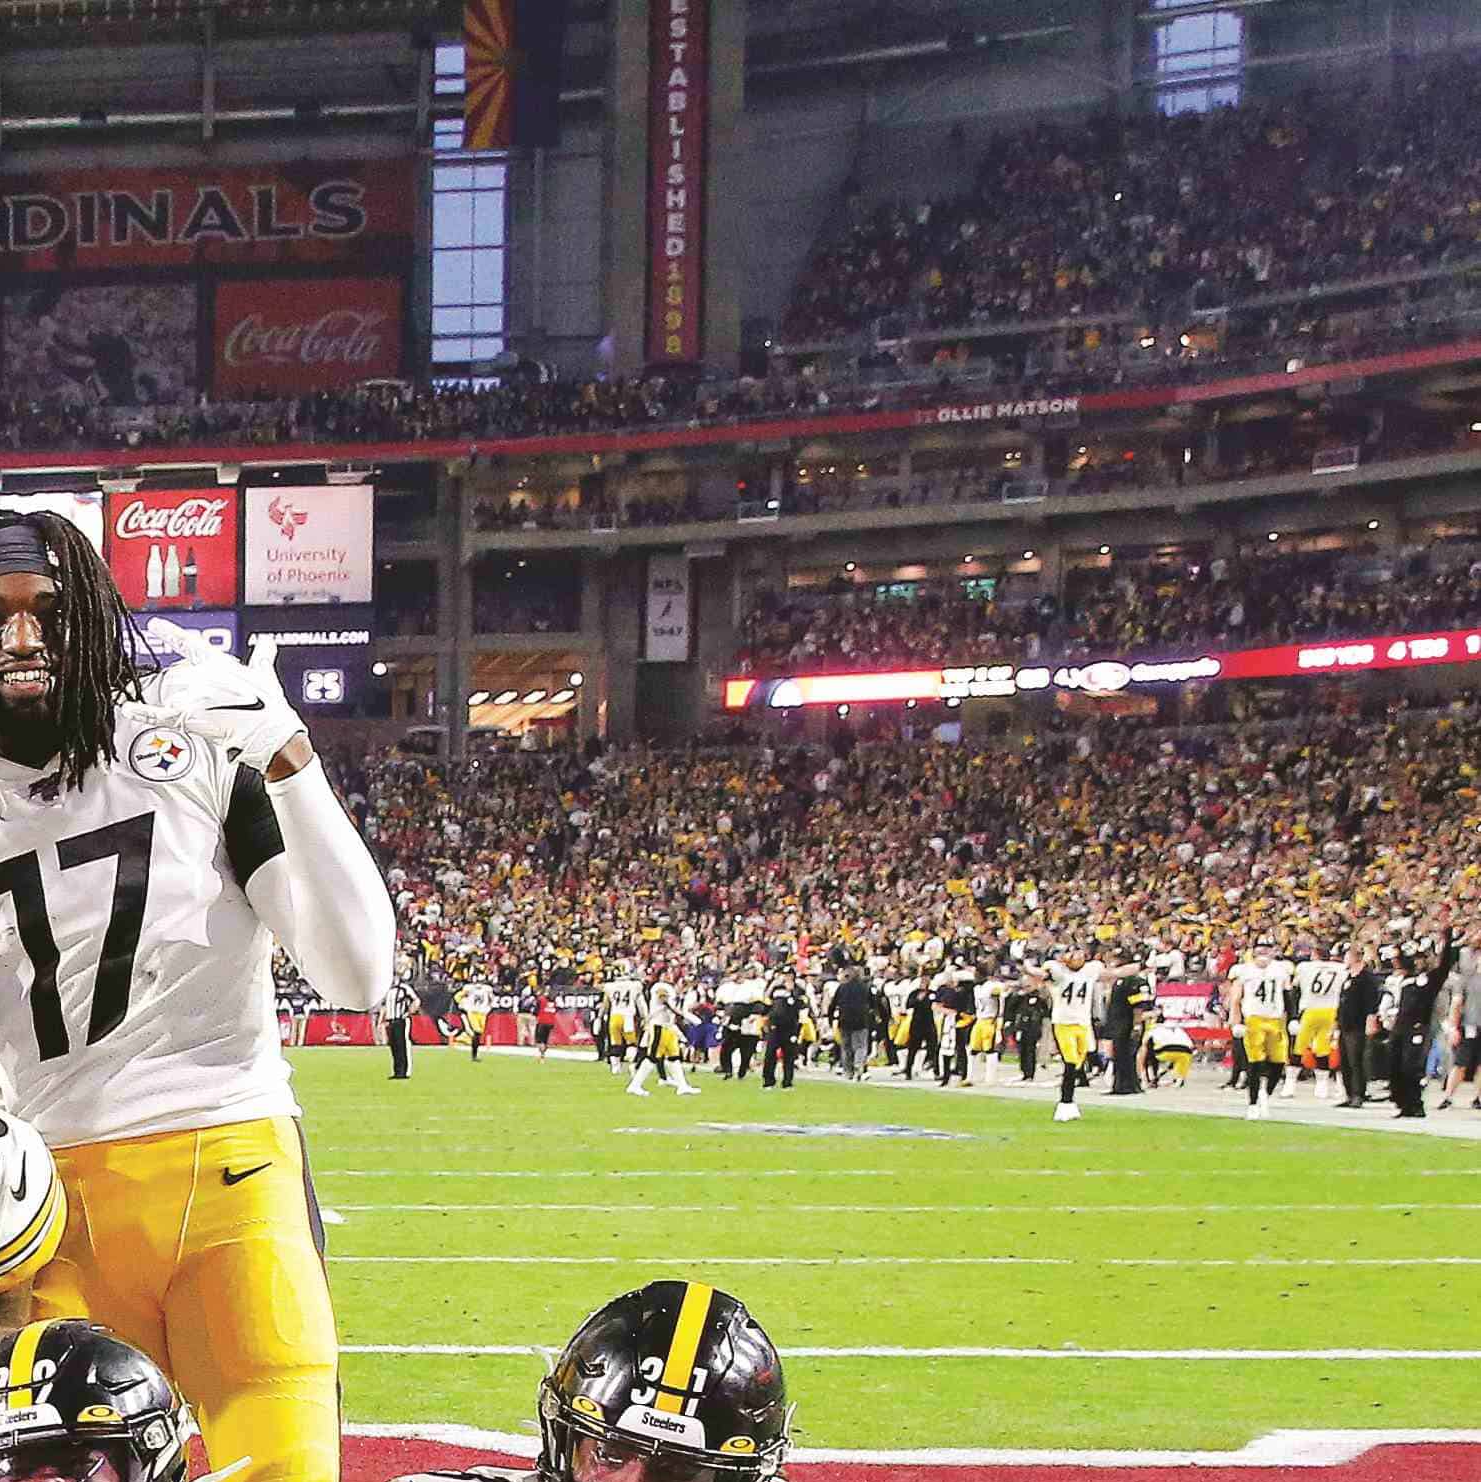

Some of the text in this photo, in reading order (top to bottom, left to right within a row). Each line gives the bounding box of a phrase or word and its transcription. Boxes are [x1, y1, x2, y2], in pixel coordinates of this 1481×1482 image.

[665, 0, 687, 256] ESTABLISHED
[937, 403, 993, 423] OLLIE
[997, 397, 1080, 418] MATSON
[266, 549, 348, 565] University
[267, 569, 350, 583] of Phoenix
[1061, 981, 1089, 1006] 44
[1255, 979, 1277, 1005] 41
[1311, 971, 1337, 995] 67
[630, 1355, 710, 1418] 31
[641, 1411, 687, 1435] Steelers
